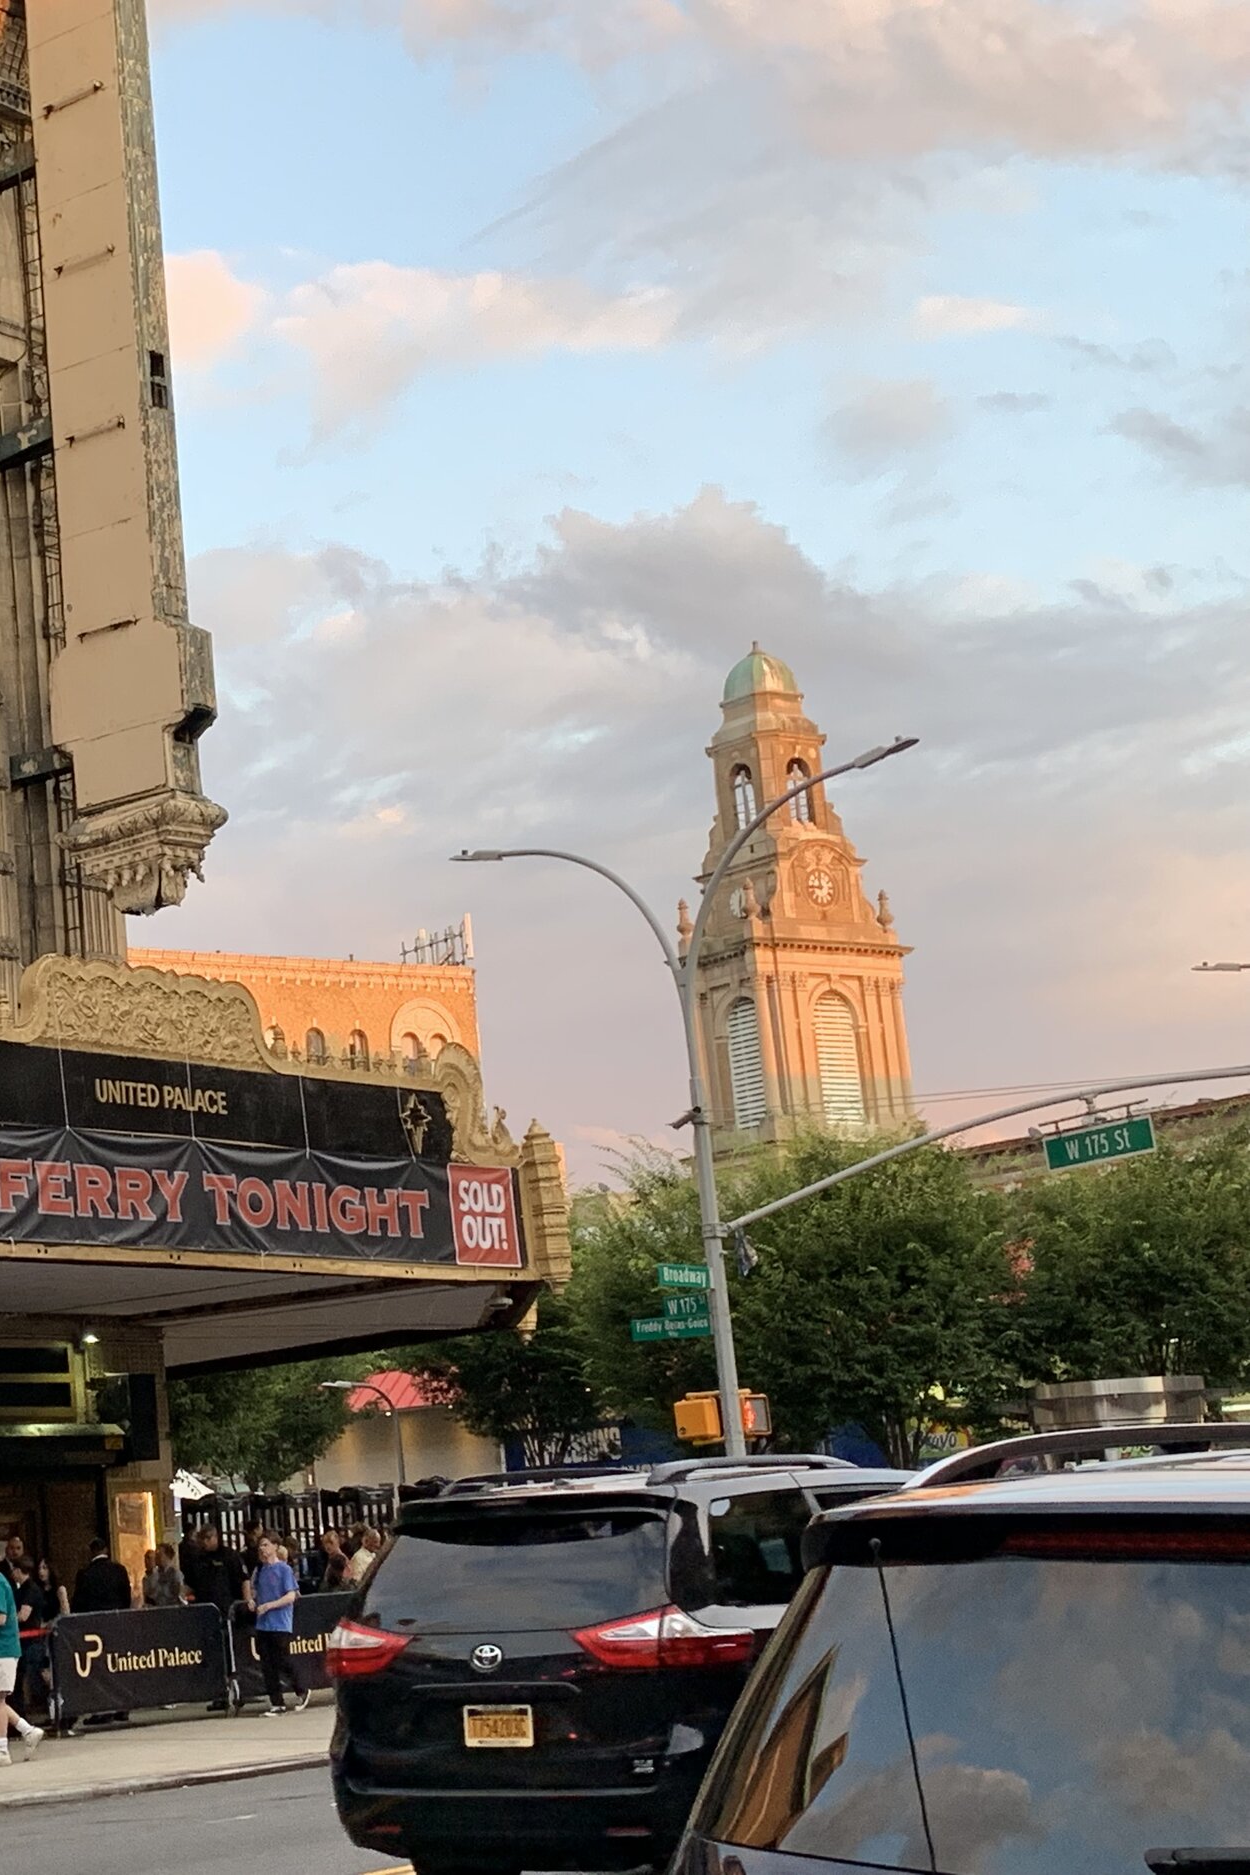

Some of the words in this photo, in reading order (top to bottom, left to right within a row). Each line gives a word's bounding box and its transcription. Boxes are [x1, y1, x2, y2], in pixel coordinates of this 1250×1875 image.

[94, 1077, 159, 1108] UNITED
[163, 1084, 229, 1116] PALACE
[1065, 1139, 1079, 1160] W
[1085, 1132, 1109, 1156] 175
[1114, 1127, 1131, 1151] St
[202, 1169, 430, 1239] TONIGHT
[457, 1178, 505, 1214] SOLD
[461, 1216, 509, 1251] OUT!
[663, 1266, 707, 1288] Broadway
[667, 1300, 678, 1316] W
[679, 1298, 697, 1314] 175
[106, 1650, 155, 1673] United
[158, 1646, 202, 1668] Palace
[289, 1635, 323, 1655] nited
